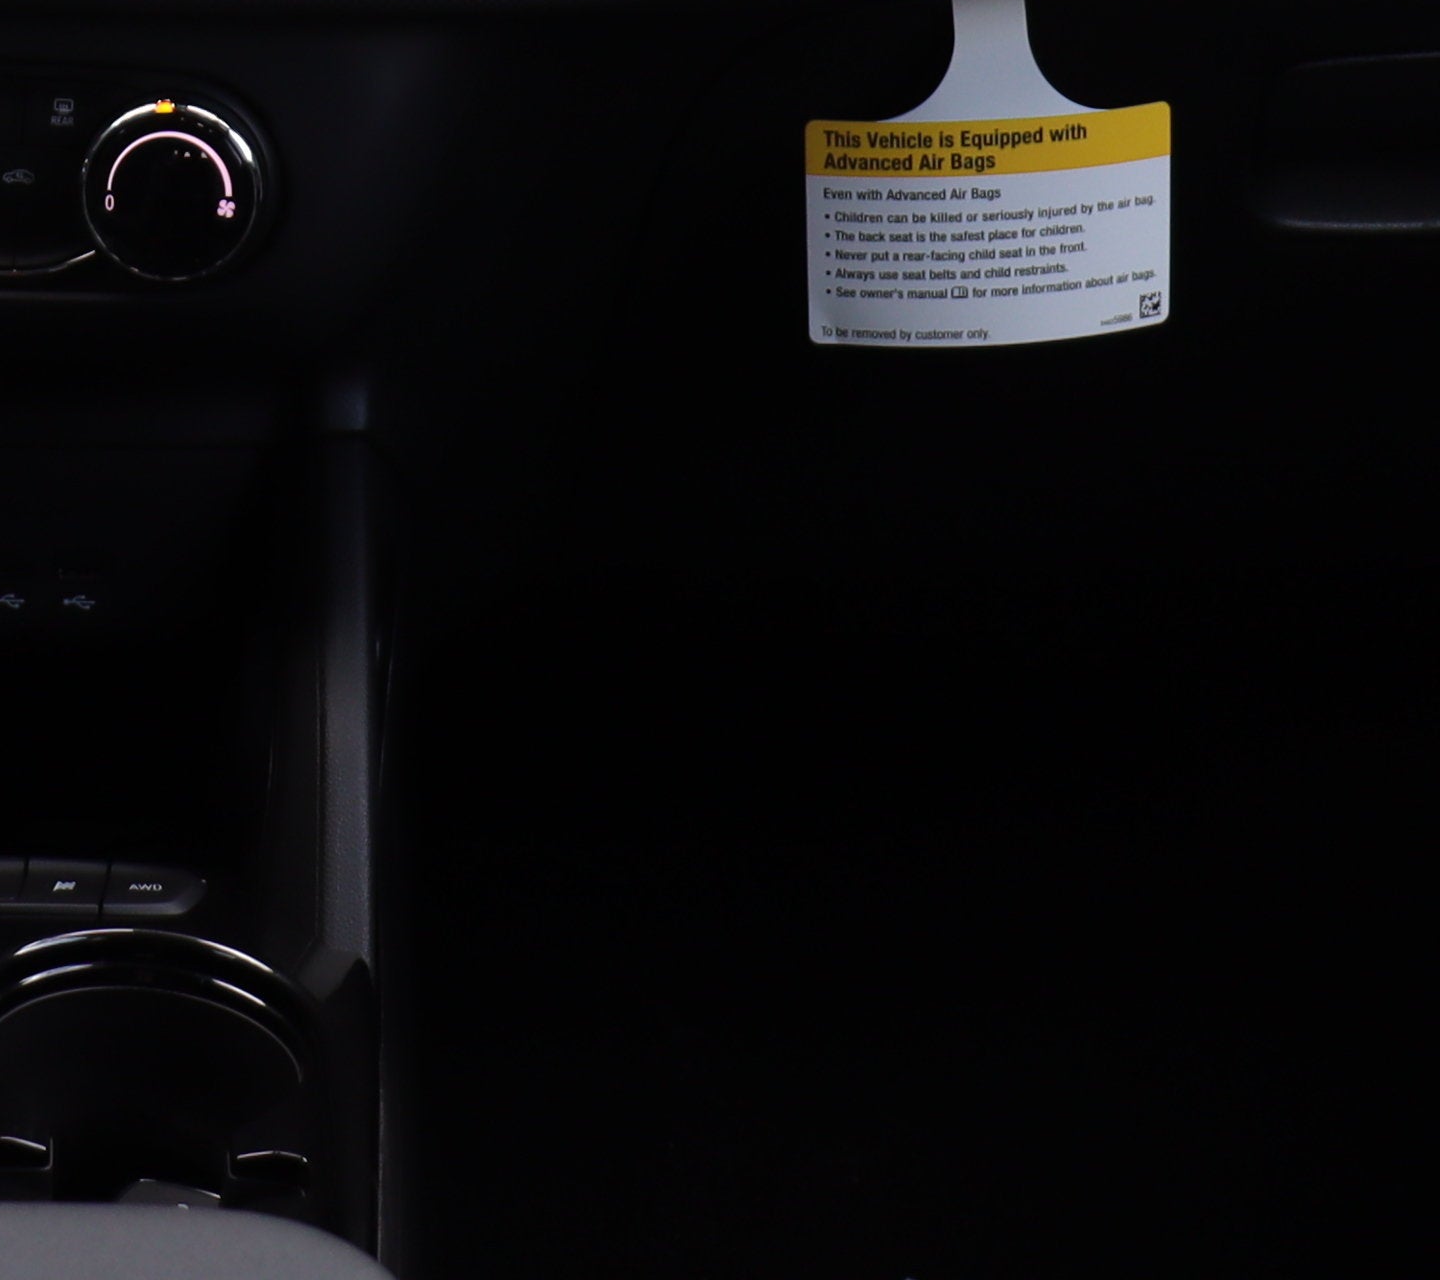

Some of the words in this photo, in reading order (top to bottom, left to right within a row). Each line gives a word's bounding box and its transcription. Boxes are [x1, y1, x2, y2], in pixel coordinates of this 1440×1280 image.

[50, 114, 75, 126] REAR
[823, 130, 861, 148] This
[867, 132, 933, 149] Vehicle
[939, 131, 954, 148] is
[960, 126, 1043, 150] Equipped
[1050, 123, 1087, 142] with
[824, 152, 913, 171] Advanced
[919, 153, 945, 170] Air
[951, 153, 996, 173] Bags
[823, 188, 852, 201] Even
[856, 189, 883, 201] with
[886, 188, 946, 201] Advanced
[950, 189, 967, 200] Air
[971, 188, 1001, 201] Bags
[834, 211, 883, 224] Children
[887, 214, 908, 224] can
[912, 212, 926, 223] be
[930, 212, 962, 223] killed
[966, 214, 978, 222] or
[982, 208, 1034, 222] seriously
[1037, 204, 1077, 219] injured
[1081, 203, 1093, 216] by
[1097, 201, 1115, 211] the
[1117, 198, 1132, 209] air
[835, 230, 855, 242] The
[858, 231, 885, 242] back
[889, 232, 913, 242] seat
[916, 231, 926, 242] is
[929, 231, 947, 242] the
[950, 230, 984, 241] safest
[988, 229, 1018, 243] place
[1021, 227, 1036, 238] for
[1039, 223, 1086, 237] children.
[835, 249, 867, 261] Never
[871, 251, 889, 263] put
[892, 253, 900, 261] a
[903, 250, 965, 263] rear-facing
[969, 248, 995, 260] child
[999, 248, 1023, 259] seat
[1025, 246, 1036, 258] in
[1039, 245, 1056, 256] the
[1059, 241, 1087, 254] front.
[835, 268, 875, 282] Always
[879, 271, 898, 280] use
[902, 269, 926, 280] seat
[929, 269, 957, 280] belts
[960, 268, 981, 279] and
[984, 266, 1011, 278] child
[1014, 262, 1069, 277] restraints.
[836, 286, 856, 298] See
[859, 287, 903, 299] owner's
[907, 288, 948, 299] manual
[972, 287, 987, 297] for
[991, 288, 1019, 297] more
[1022, 280, 1082, 295] information
[1085, 275, 1113, 288] about
[1116, 272, 1129, 283] air
[1131, 268, 1157, 281] bags.
[821, 325, 833, 337] To
[835, 326, 849, 337] be
[852, 328, 896, 339] removed
[900, 329, 912, 341] by
[914, 329, 963, 339] customer
[966, 328, 990, 340] only.
[129, 882, 164, 892] AWD
